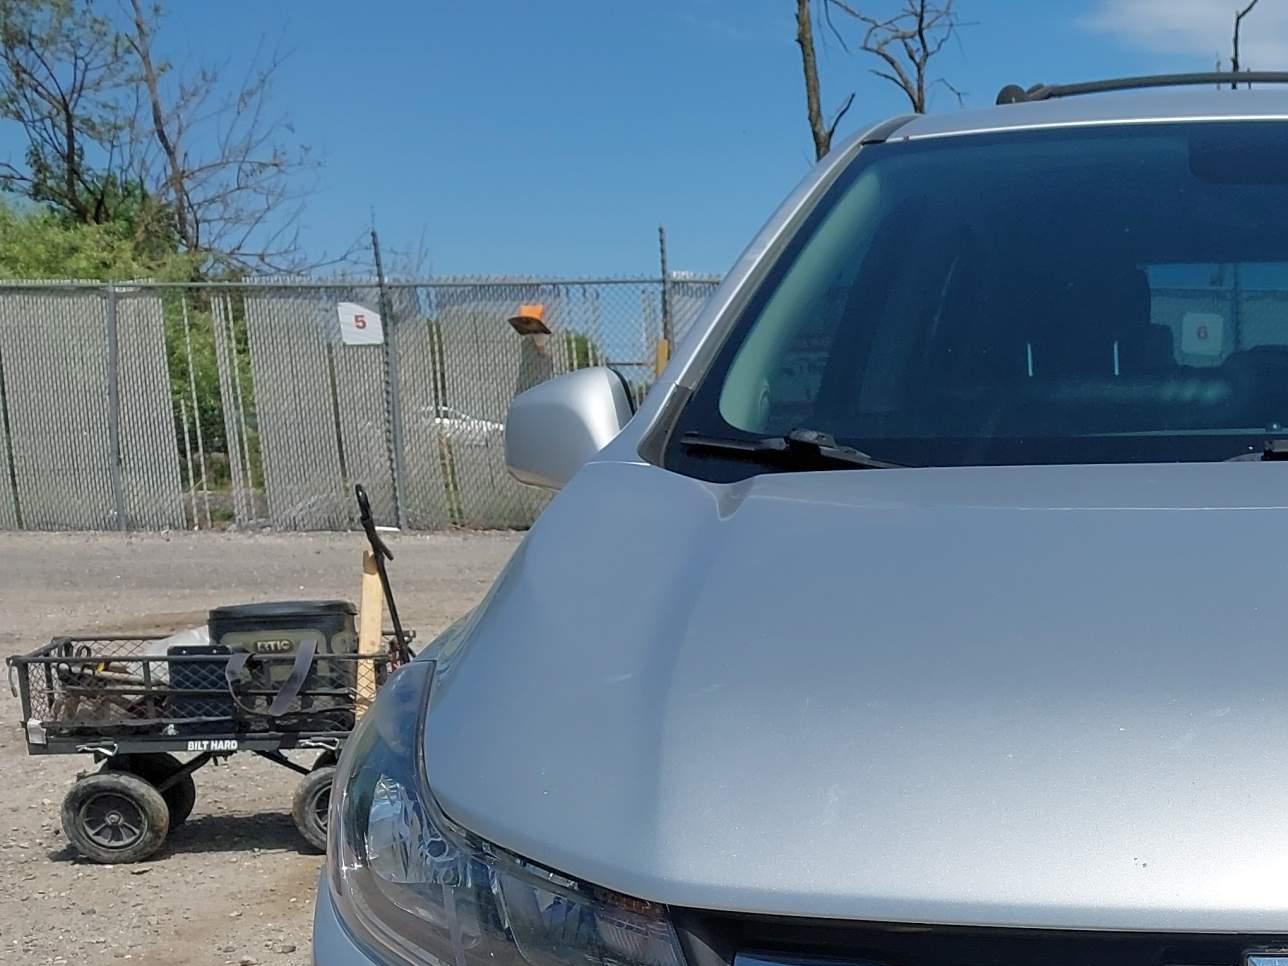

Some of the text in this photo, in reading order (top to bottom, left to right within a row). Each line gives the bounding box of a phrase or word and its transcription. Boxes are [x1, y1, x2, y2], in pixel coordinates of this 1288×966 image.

[354, 314, 367, 330] 5
[1197, 325, 1208, 341] 6
[187, 740, 239, 751] BILT HARD
